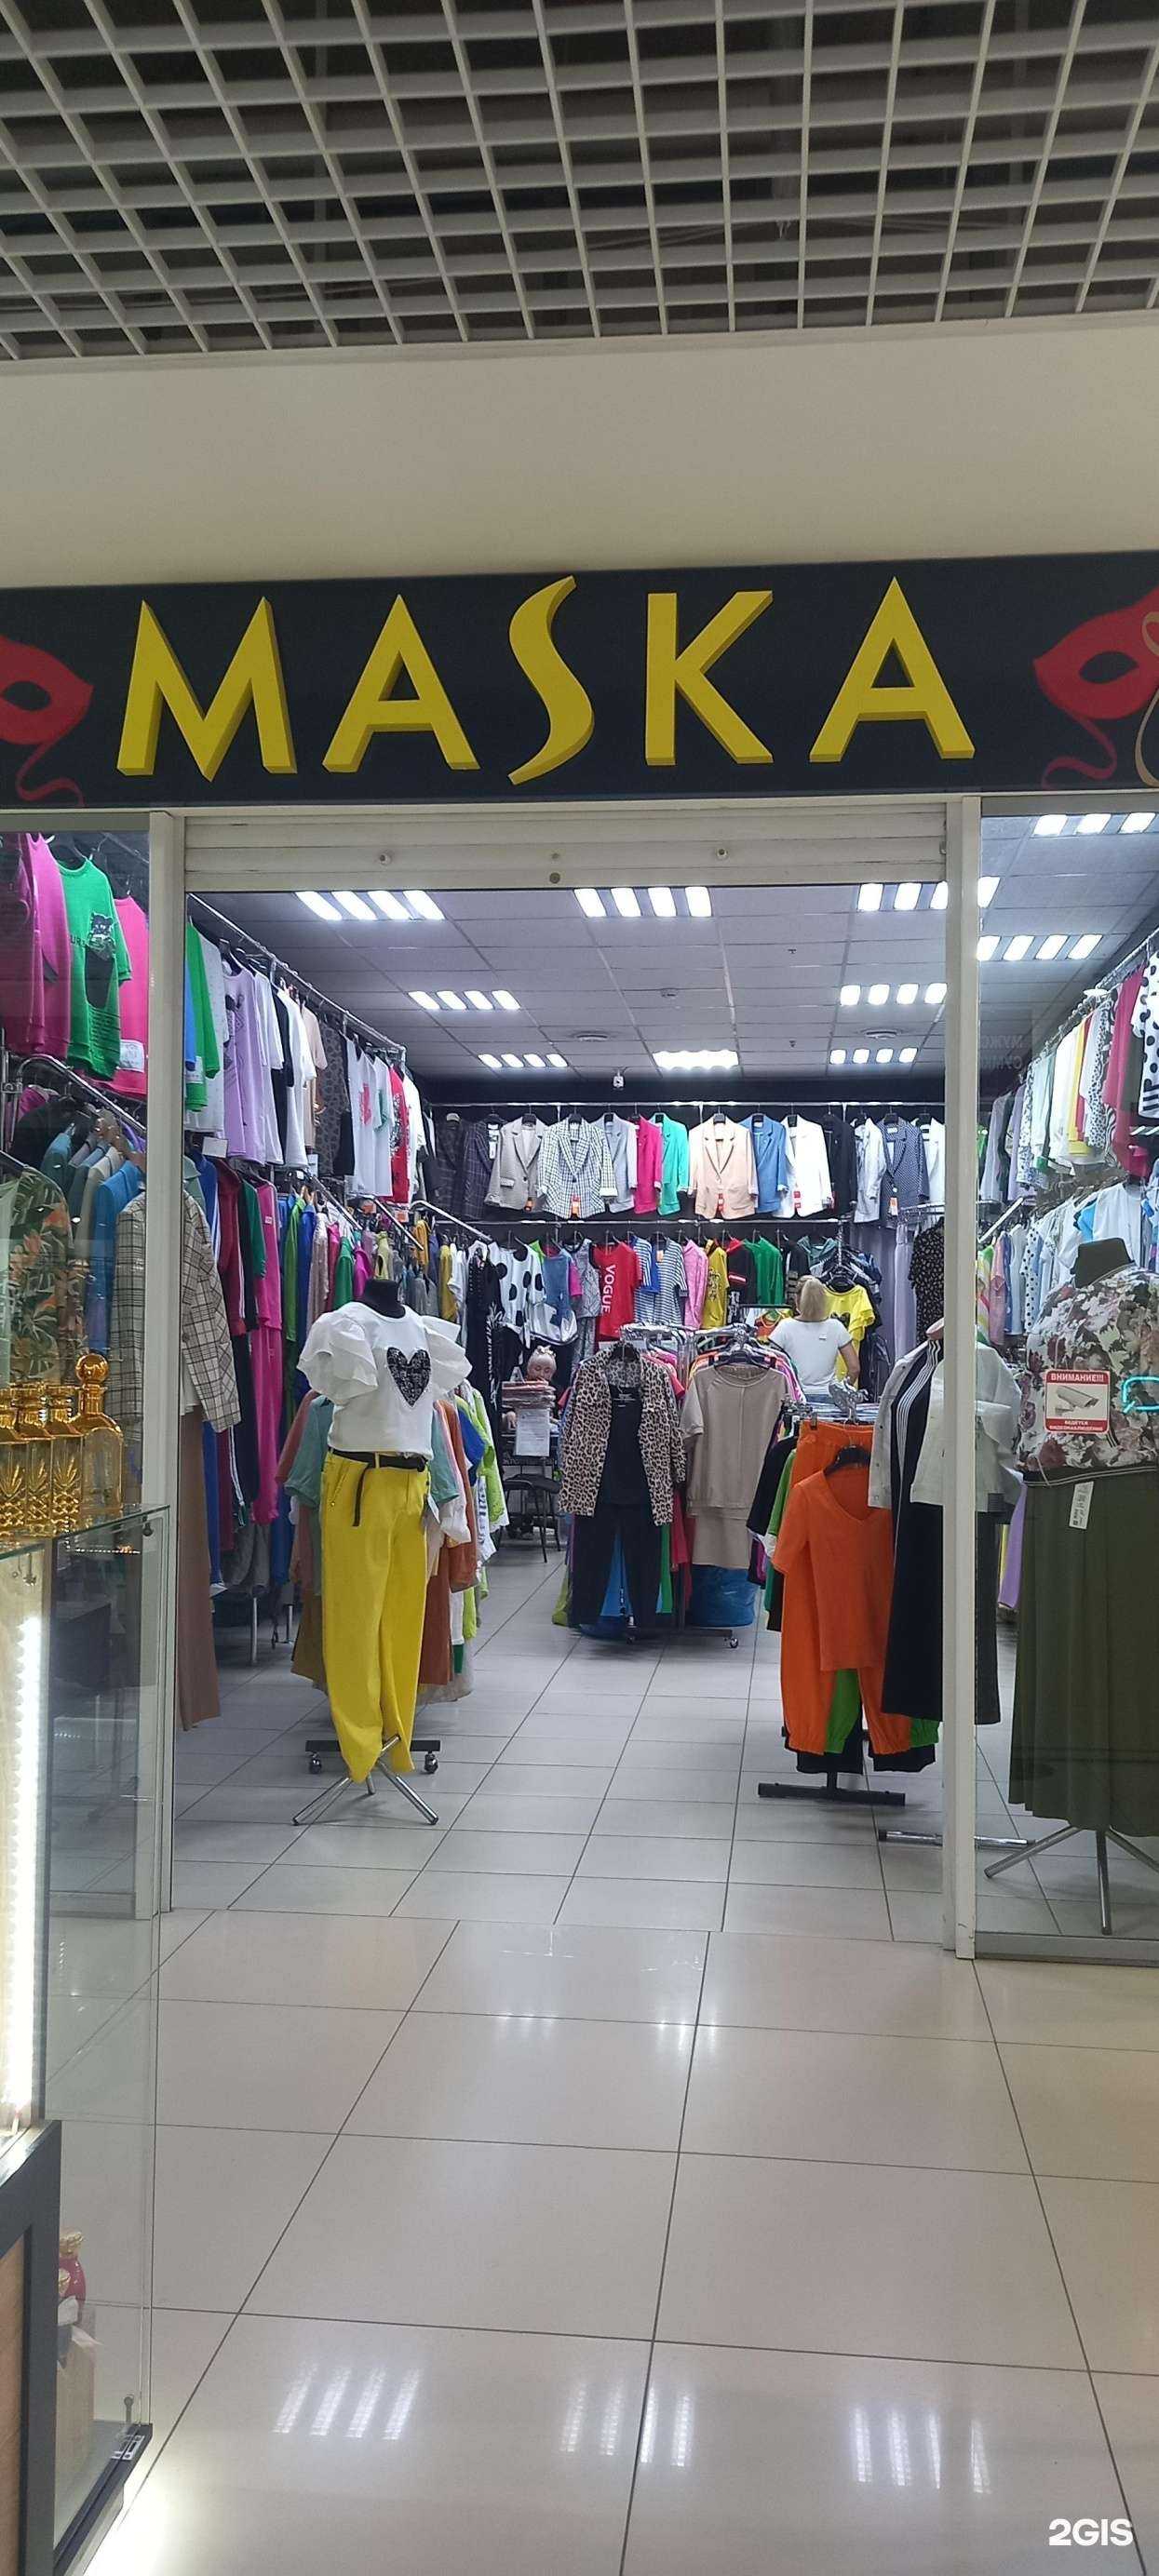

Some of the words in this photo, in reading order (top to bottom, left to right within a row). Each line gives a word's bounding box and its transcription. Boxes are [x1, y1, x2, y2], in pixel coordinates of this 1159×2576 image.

[116, 575, 975, 785] MASKA
[601, 1264, 616, 1315] VOGUE
[1050, 1373, 1104, 1382] ВНИМАНИЕ!!!
